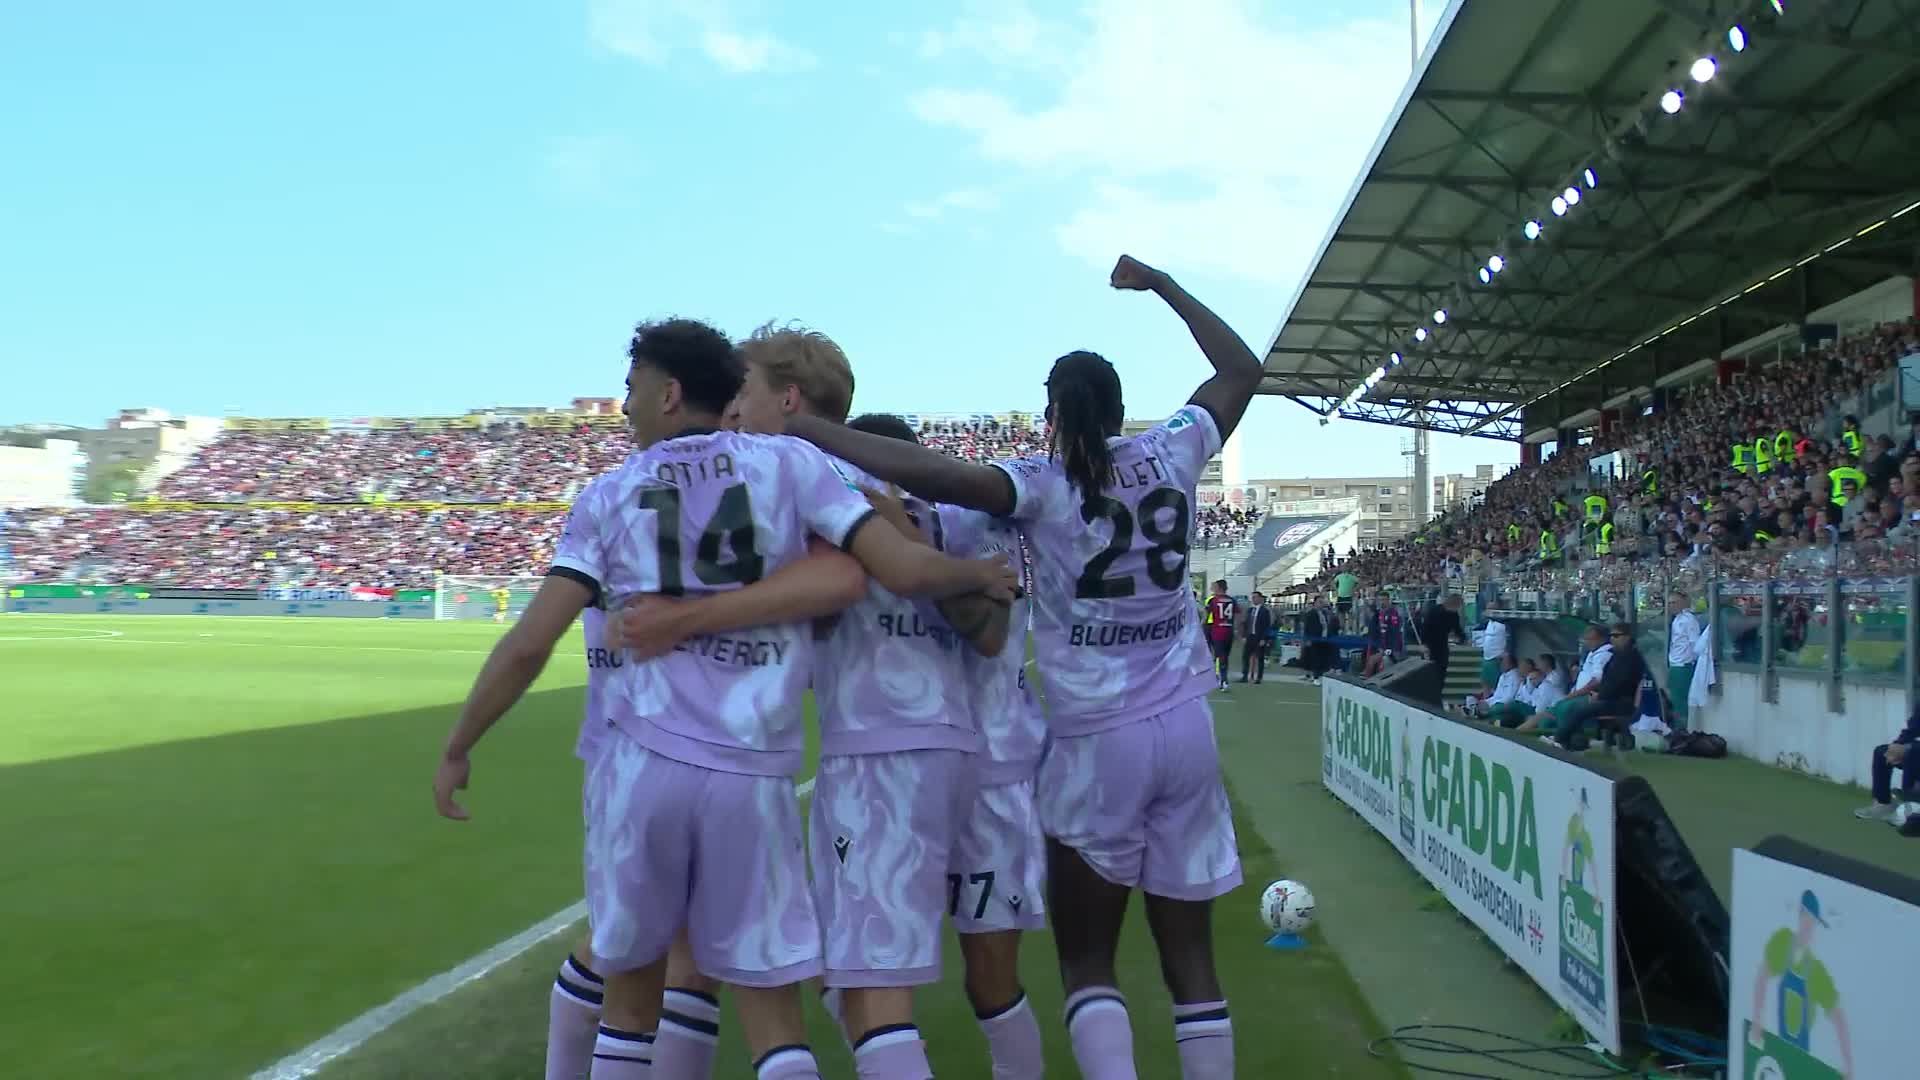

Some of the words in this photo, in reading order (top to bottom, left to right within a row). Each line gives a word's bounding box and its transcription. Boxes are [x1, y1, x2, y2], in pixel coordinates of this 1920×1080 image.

[1111, 456, 1161, 489] LET
[639, 481, 765, 597] 14
[1075, 487, 1191, 599] 28
[1216, 602, 1233, 620] 14
[1336, 695, 1394, 792] CFADDA
[1421, 735, 1543, 901] CFADDA
[1471, 866, 1526, 942] SARDEGNA
